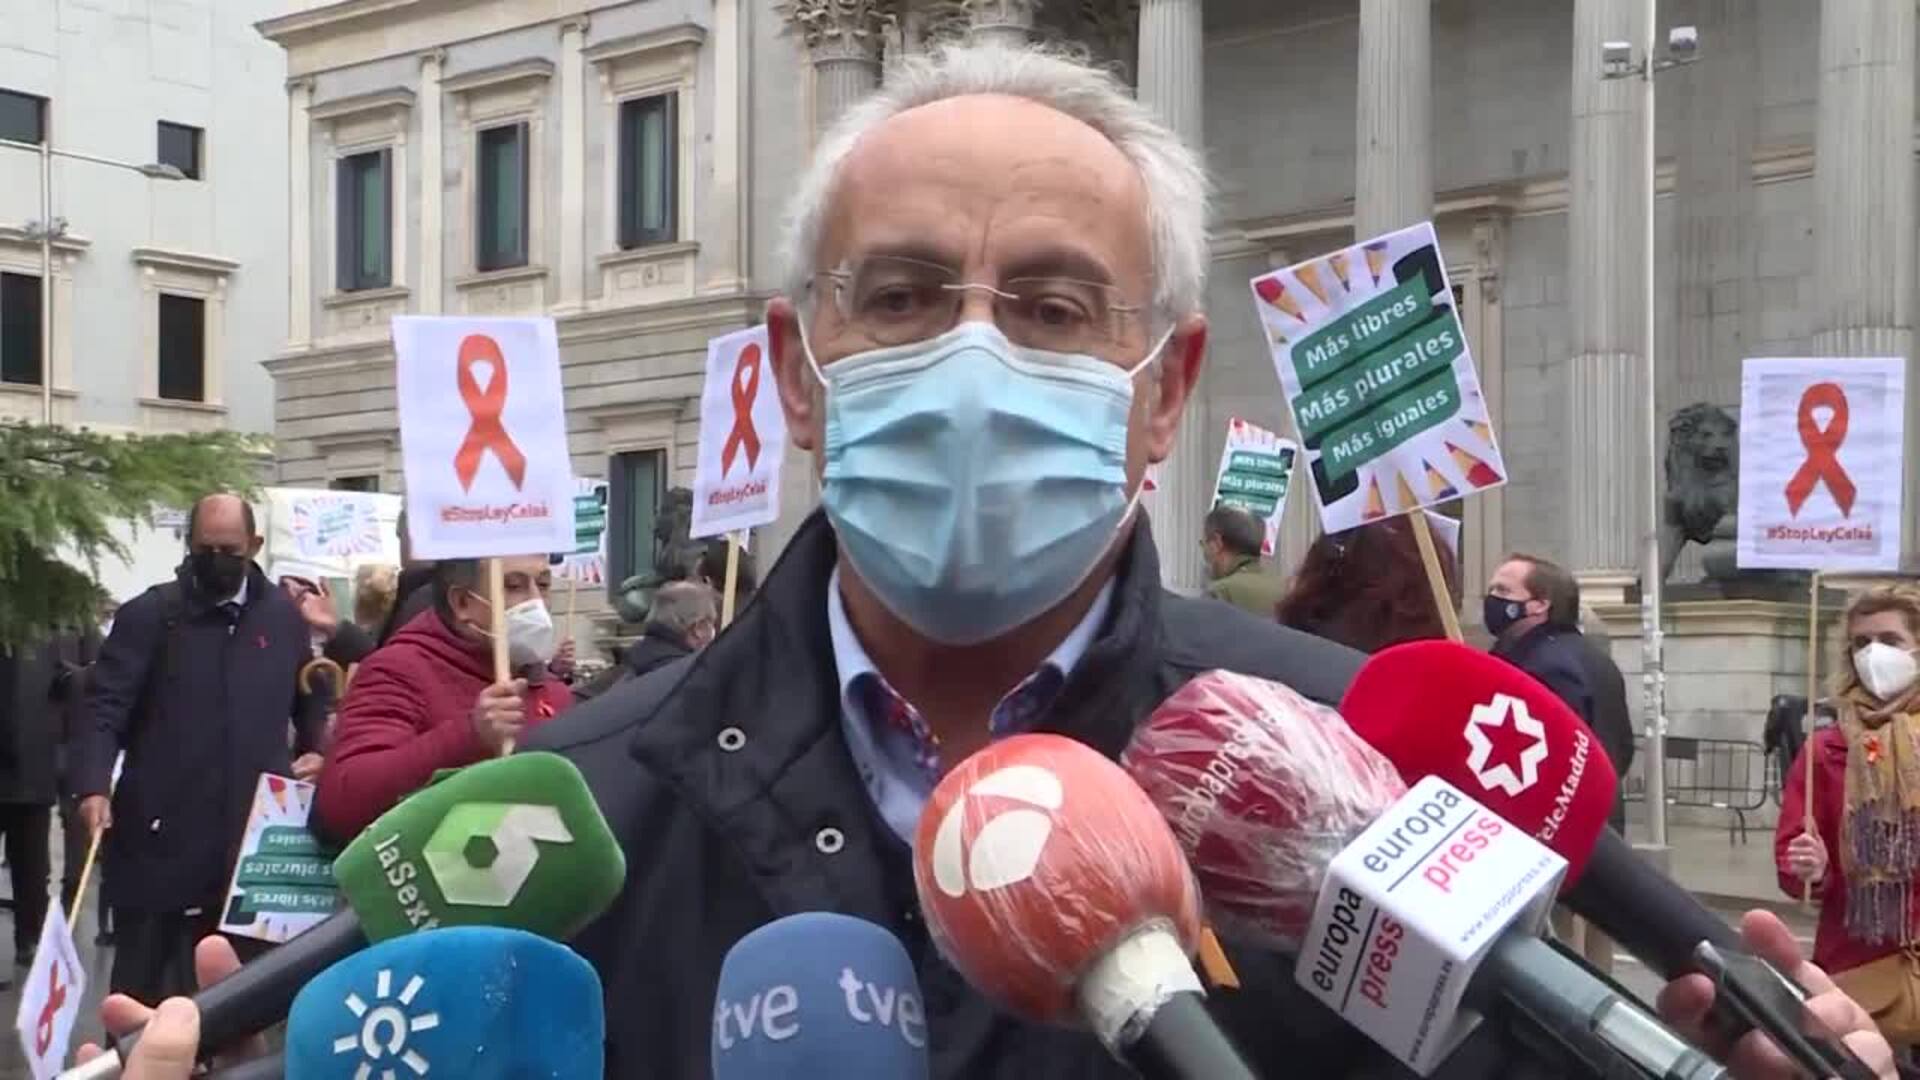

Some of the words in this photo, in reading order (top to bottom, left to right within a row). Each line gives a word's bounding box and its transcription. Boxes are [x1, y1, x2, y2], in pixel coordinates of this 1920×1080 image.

[1305, 336, 1350, 369] Más
[1351, 294, 1417, 341] libres
[1299, 388, 1350, 427] Más
[1355, 330, 1454, 400] plurales
[1332, 431, 1374, 463] Más
[1376, 389, 1449, 439] iguales
[244, 862, 319, 877] plurales
[1363, 789, 1461, 873] europa
[1423, 817, 1503, 893] press
[1311, 887, 1362, 992] europa
[1360, 917, 1403, 1009] press
[715, 984, 799, 1050] tve
[839, 966, 926, 1048] tve
